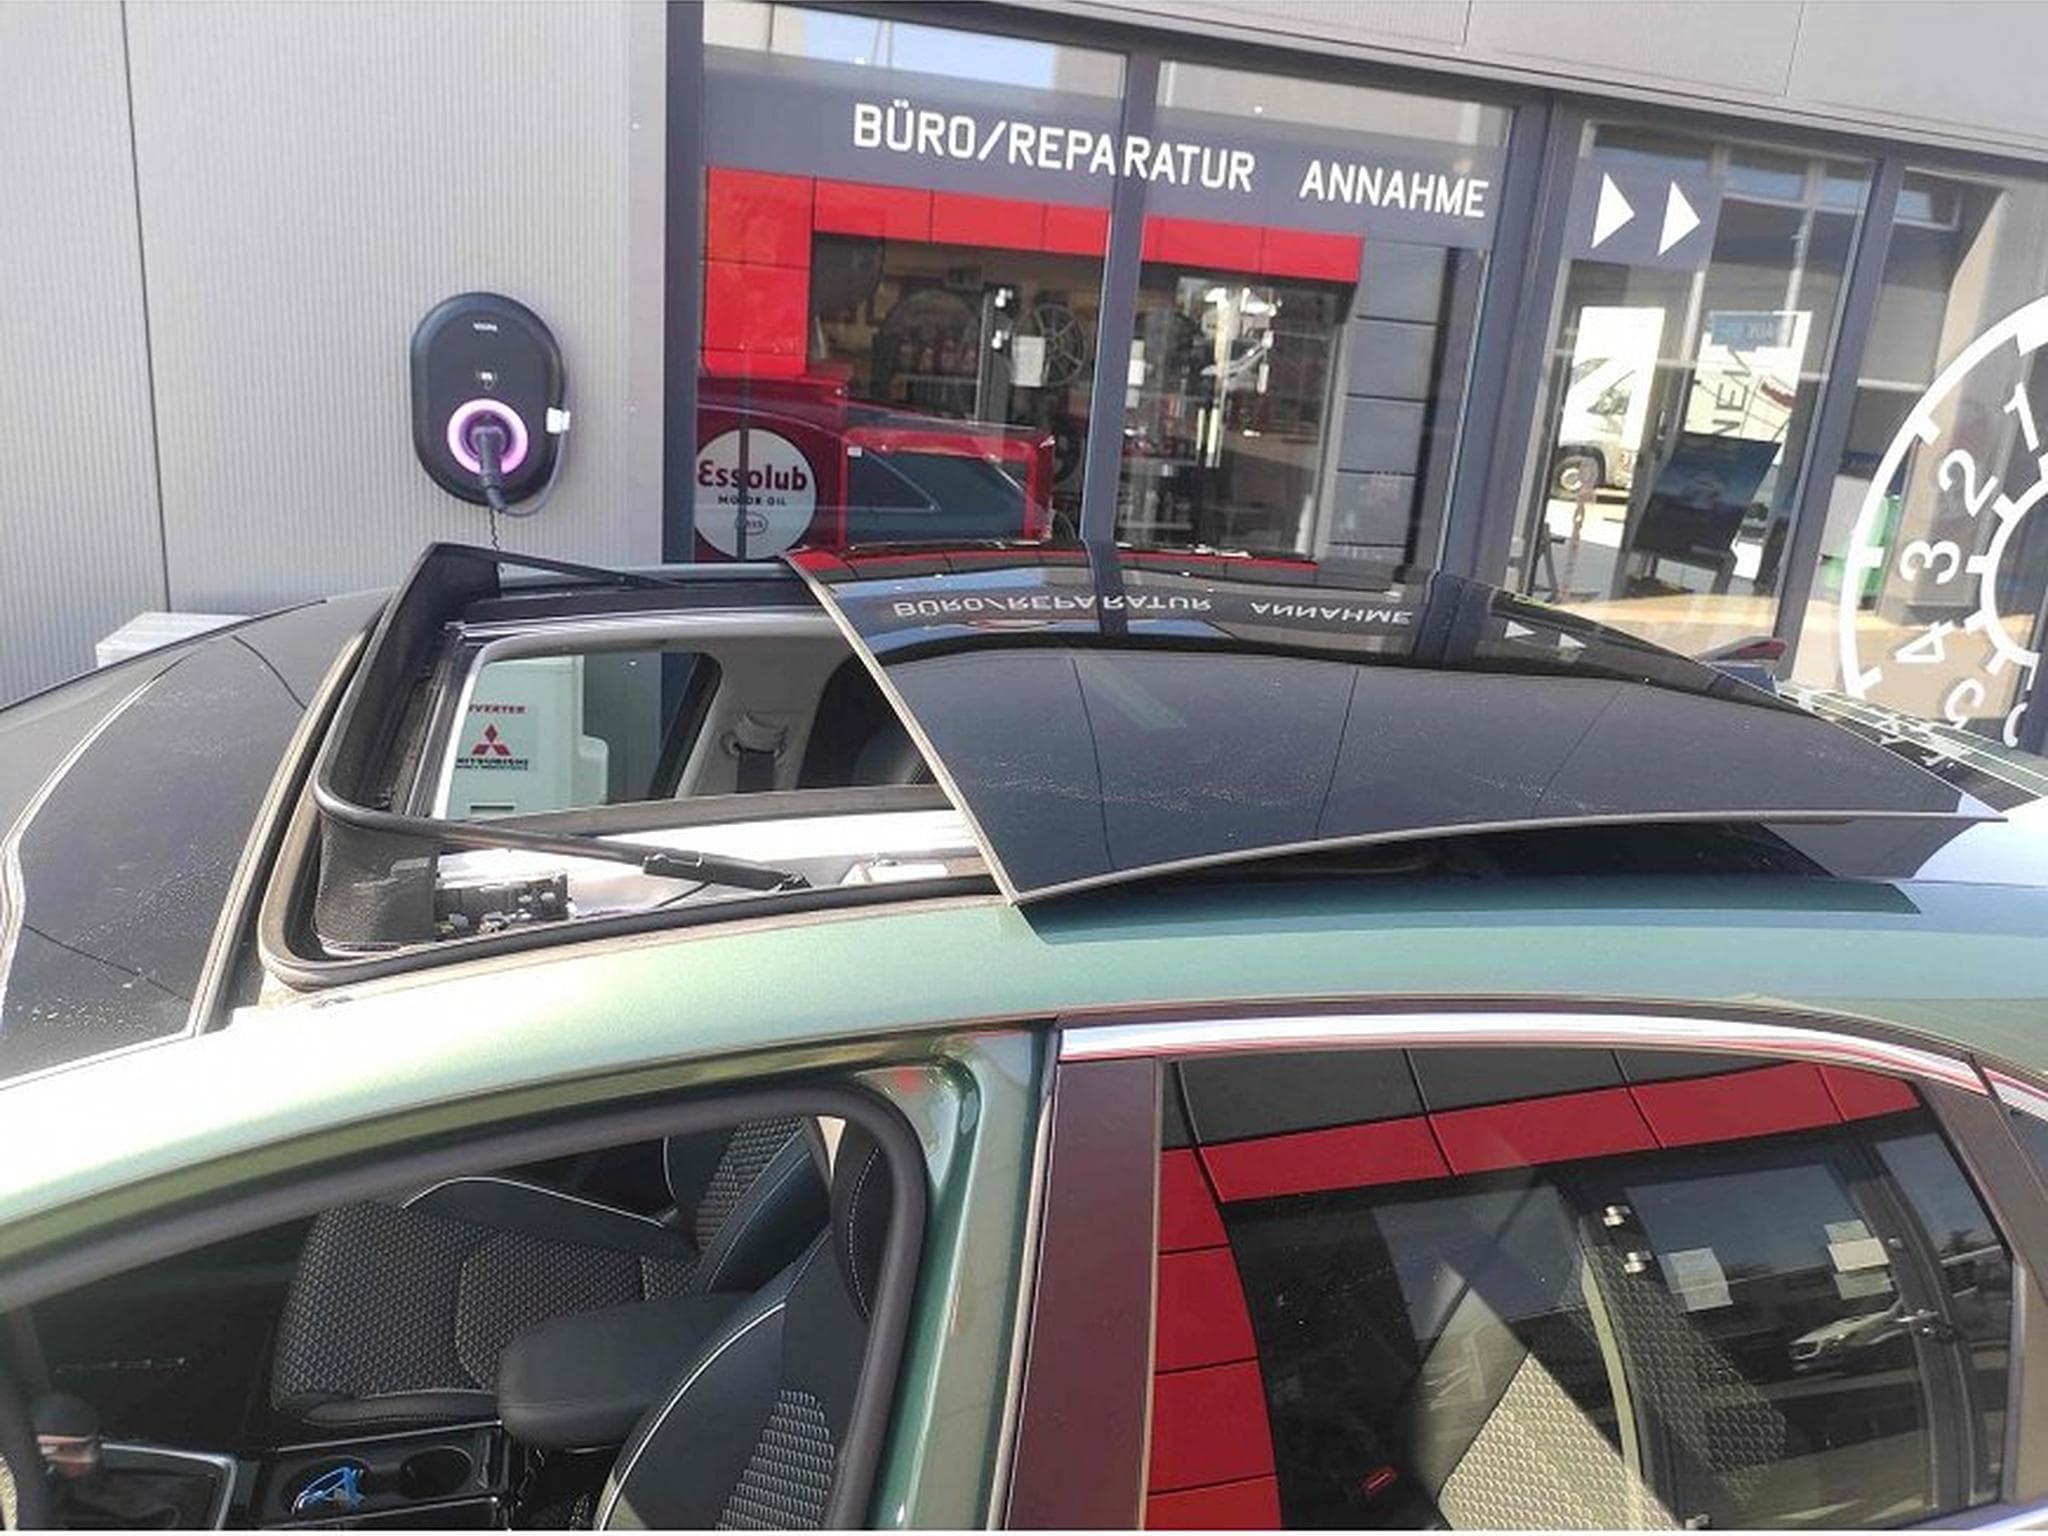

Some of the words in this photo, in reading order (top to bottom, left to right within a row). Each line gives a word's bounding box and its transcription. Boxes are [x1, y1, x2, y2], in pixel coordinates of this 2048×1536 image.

[853, 99, 1256, 193] BÜRO/REPARATUR
[1298, 159, 1490, 218] ANNAHME
[2004, 382, 2040, 452] 1
[698, 459, 808, 491] Essolub
[1937, 448, 1998, 518] 2
[718, 495, 762, 505] MOOR
[767, 496, 787, 506] OIL
[1899, 539, 1962, 584] 3
[1895, 619, 1954, 663] 4
